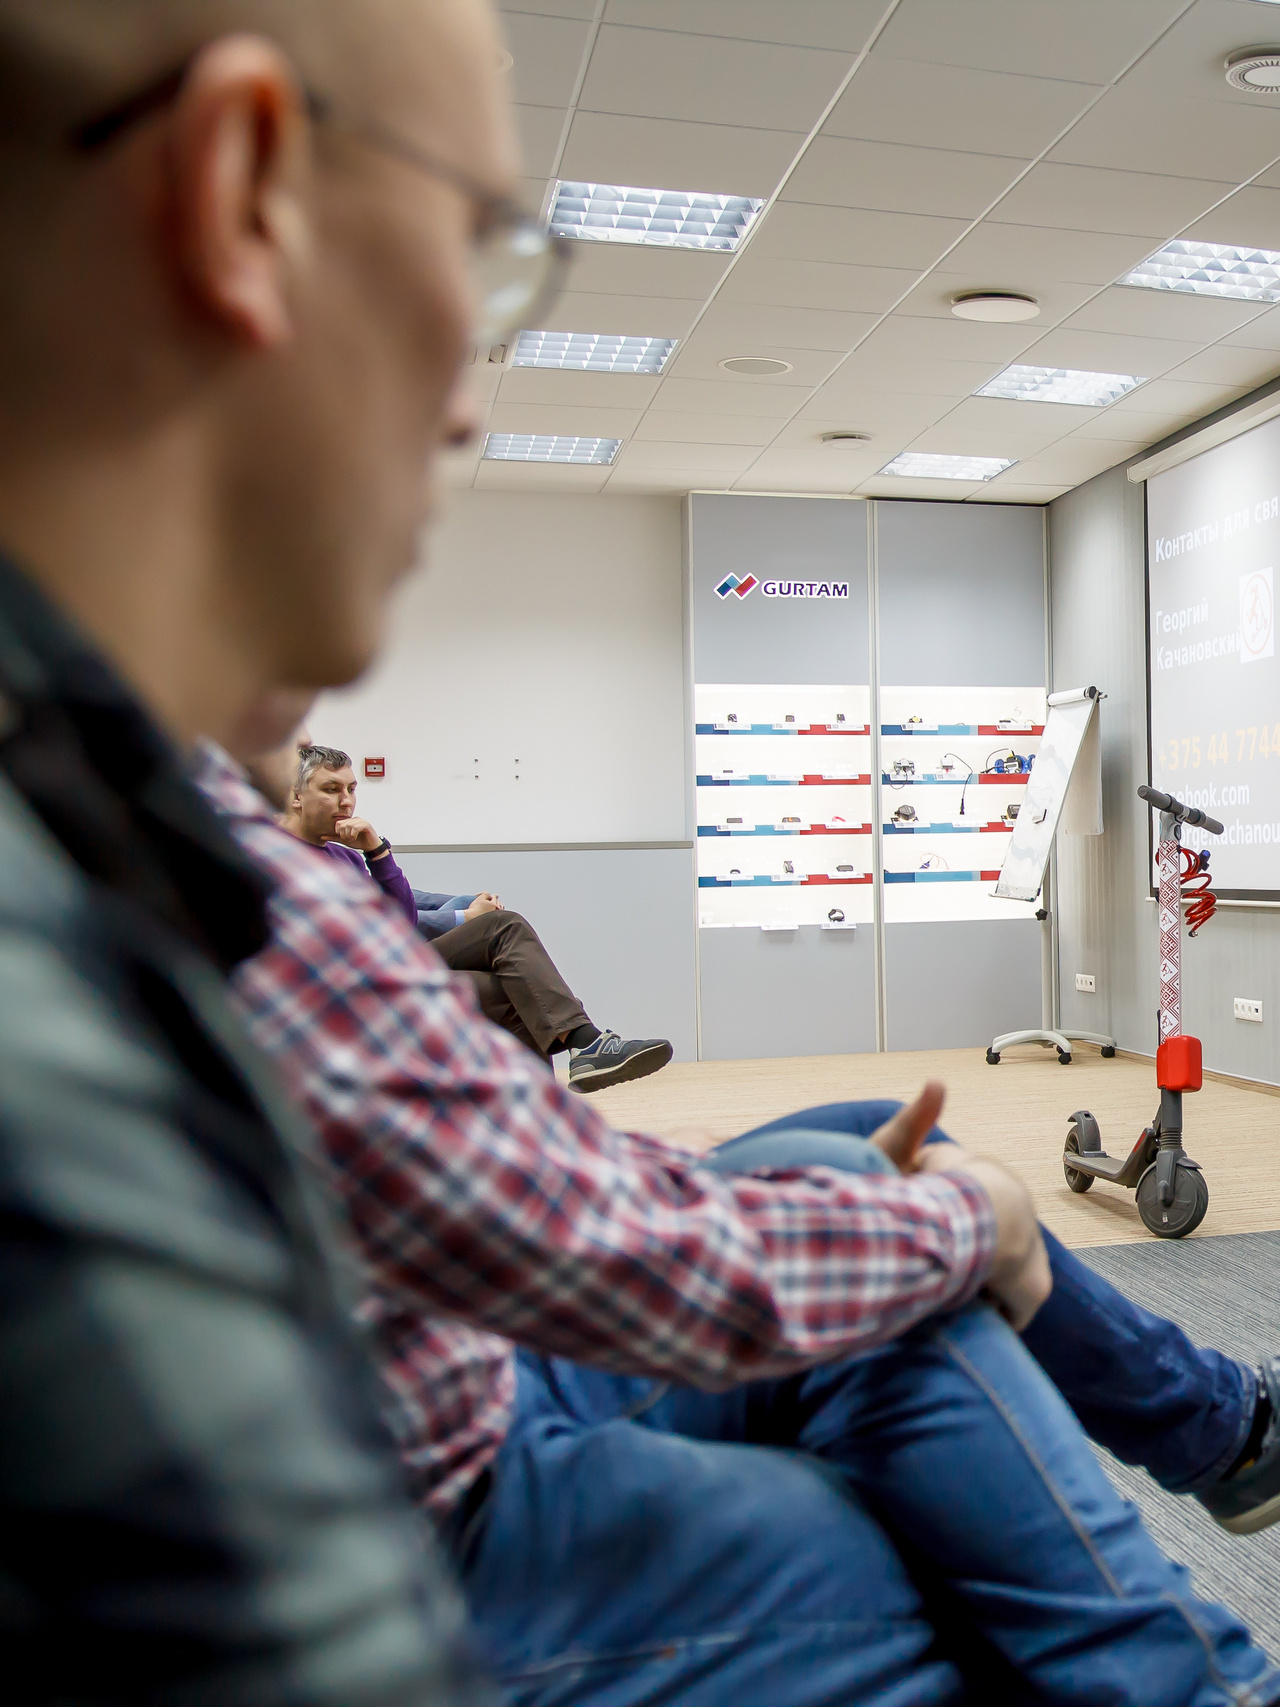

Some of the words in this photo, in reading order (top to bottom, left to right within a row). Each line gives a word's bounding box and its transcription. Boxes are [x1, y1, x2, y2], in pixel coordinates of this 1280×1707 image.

[1155, 520, 1218, 562] Контакты
[1223, 508, 1249, 540] для
[763, 581, 848, 598] GURTAM
[1155, 595, 1209, 635] Георгий
[1158, 735, 1201, 771] +375
[1207, 731, 1229, 766] 44
[1160, 782, 1250, 808] ebook.com
